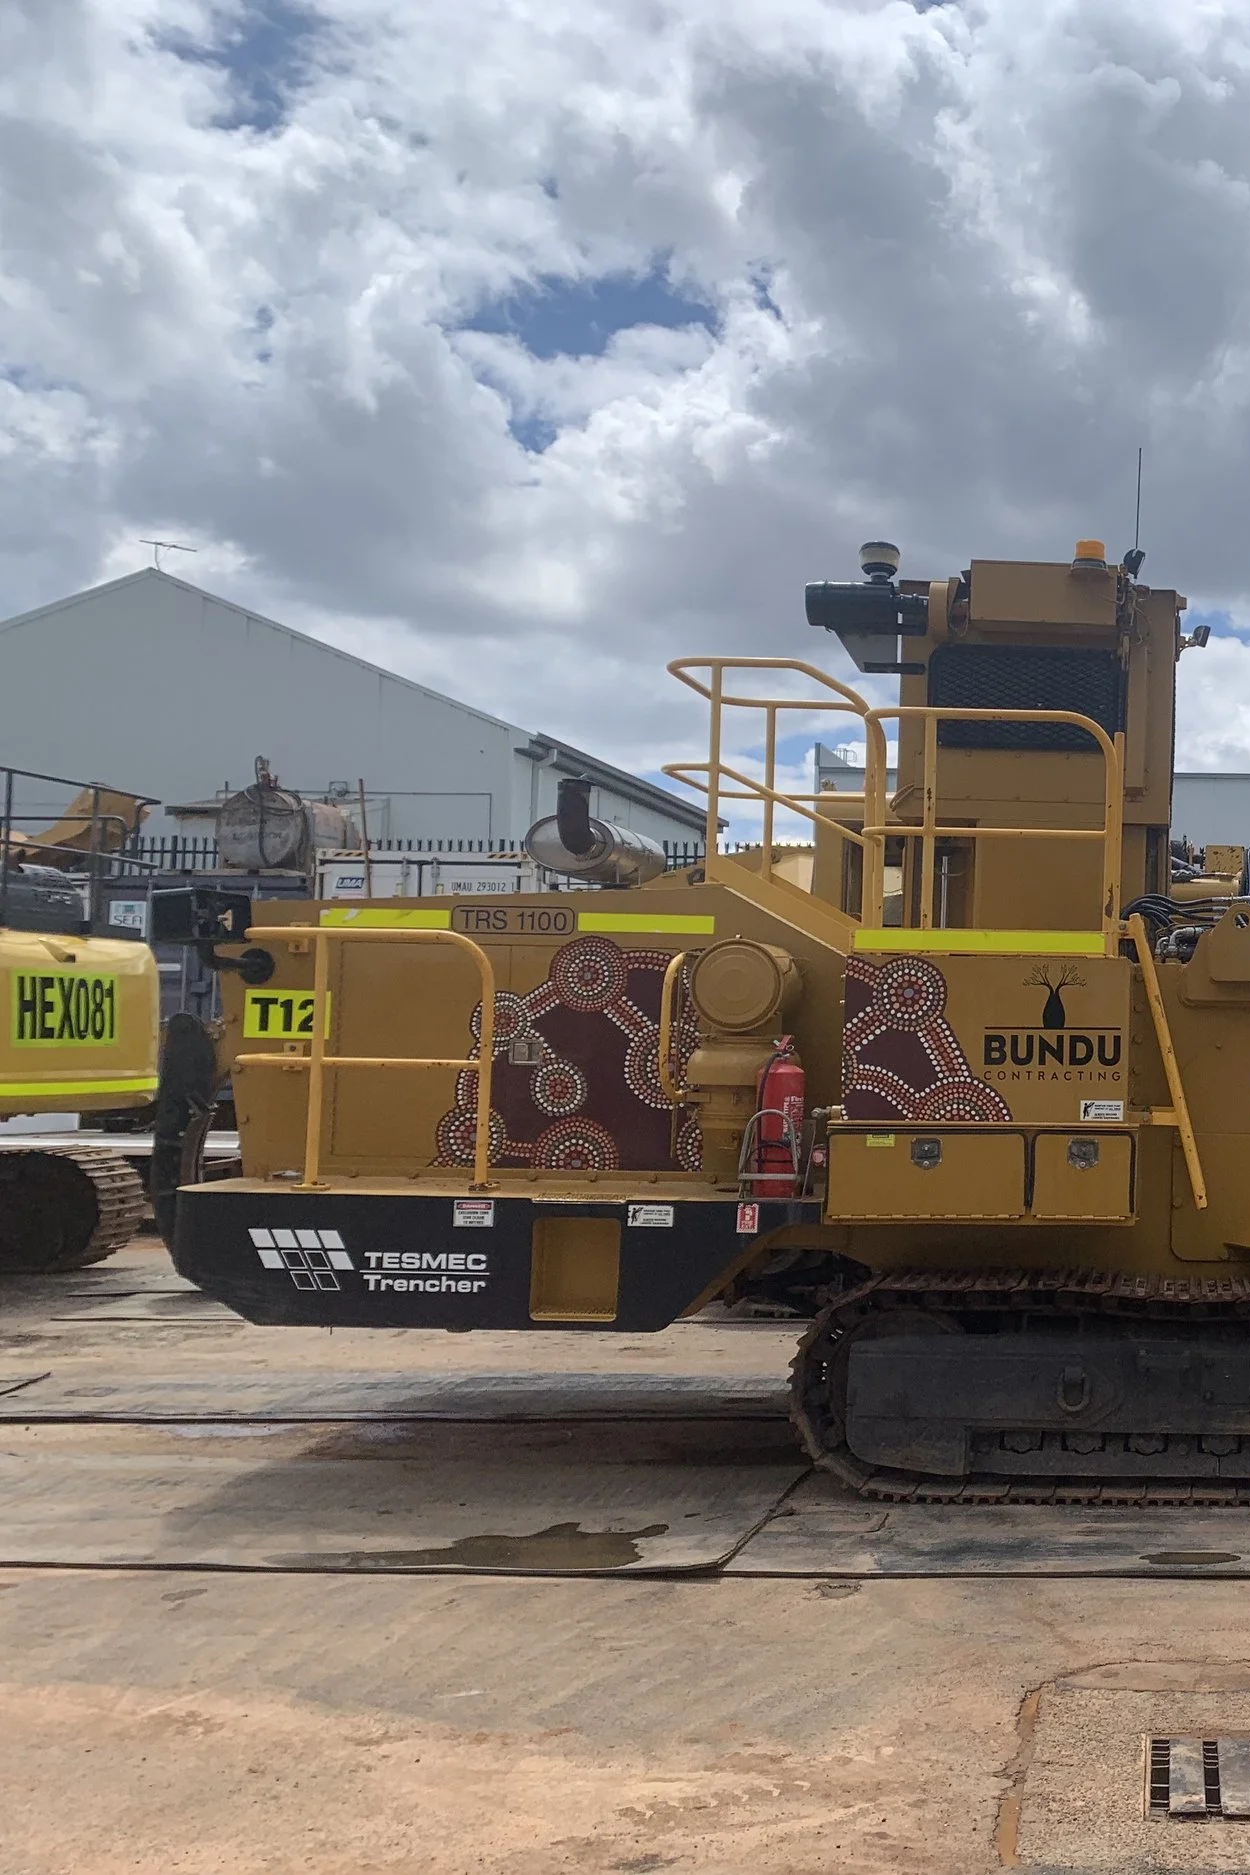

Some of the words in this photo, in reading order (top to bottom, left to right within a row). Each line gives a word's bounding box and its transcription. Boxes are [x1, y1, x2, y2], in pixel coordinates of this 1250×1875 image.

[338, 877, 363, 888] UMA
[451, 882, 472, 892] UMAU
[476, 882, 506, 892] 293012
[460, 909, 507, 930] TRS
[517, 911, 567, 931] 1100
[16, 976, 115, 1040] HEX081
[984, 1034, 1121, 1067] BUNDU
[983, 1071, 1121, 1081] CONTRACTING
[363, 1251, 487, 1271] TESMEC
[363, 1274, 487, 1293] Trencher
